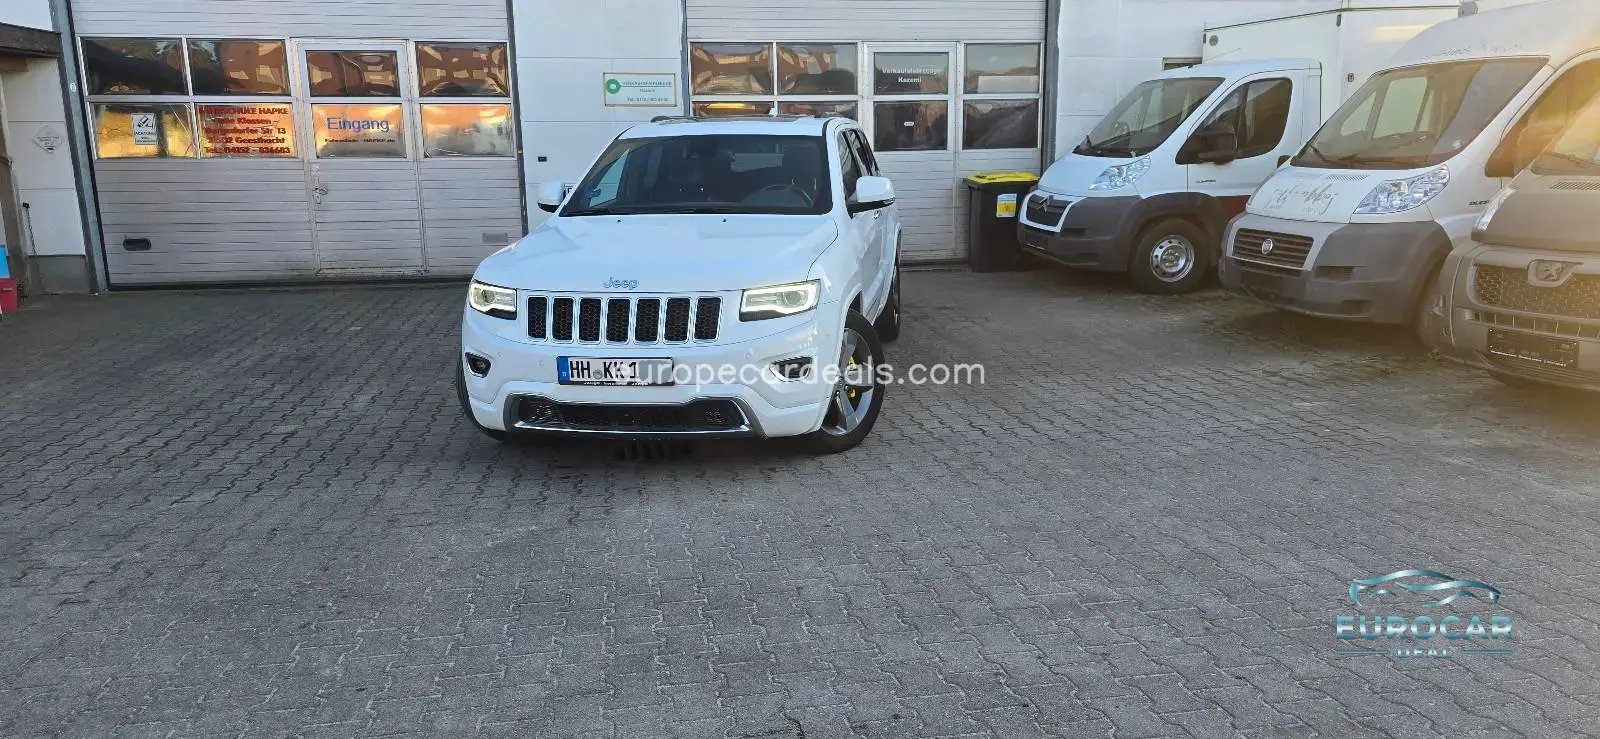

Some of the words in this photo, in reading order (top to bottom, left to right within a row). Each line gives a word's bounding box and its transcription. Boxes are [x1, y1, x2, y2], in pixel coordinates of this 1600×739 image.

[259, 107, 289, 115] HAPKE
[326, 117, 390, 133] Eingang
[277, 127, 287, 135] 13
[235, 136, 286, 144] Geesthacht
[602, 276, 640, 290] Jeep
[569, 360, 591, 379] HH
